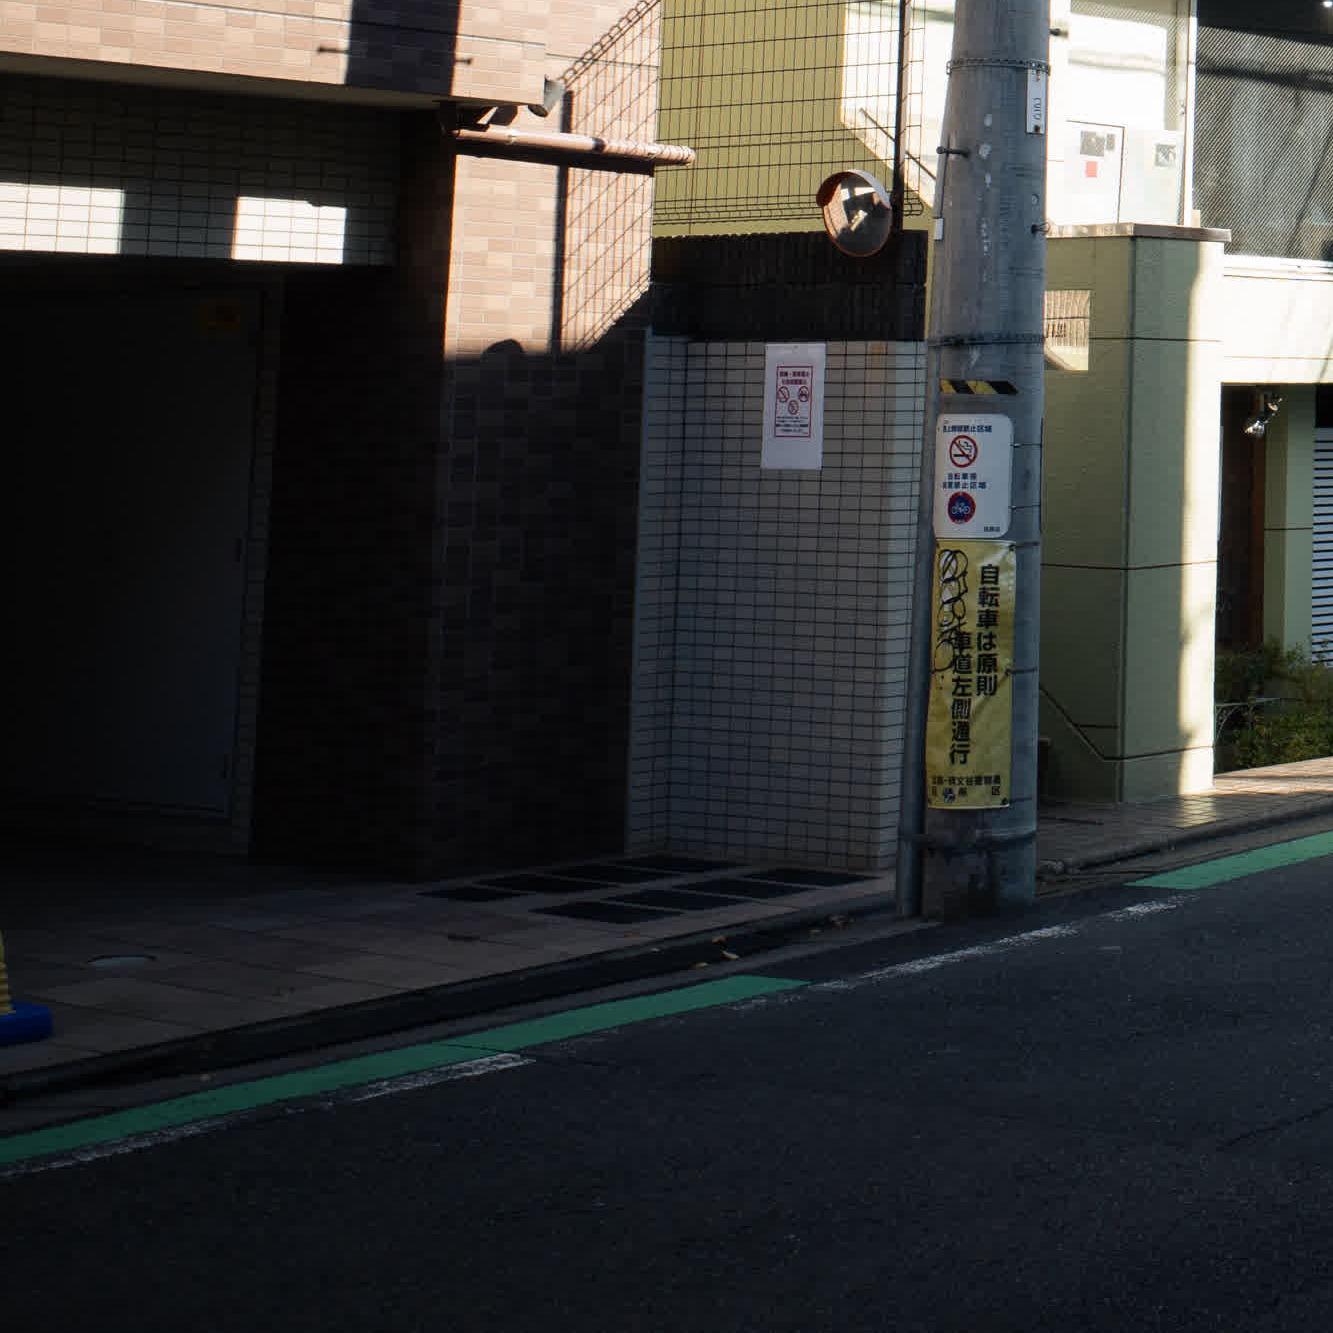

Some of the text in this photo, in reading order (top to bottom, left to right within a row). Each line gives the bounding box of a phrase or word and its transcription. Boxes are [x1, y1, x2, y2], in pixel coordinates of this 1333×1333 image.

[975, 563, 1001, 698] 自転車は原則
[949, 631, 973, 765] 車道左側通行
